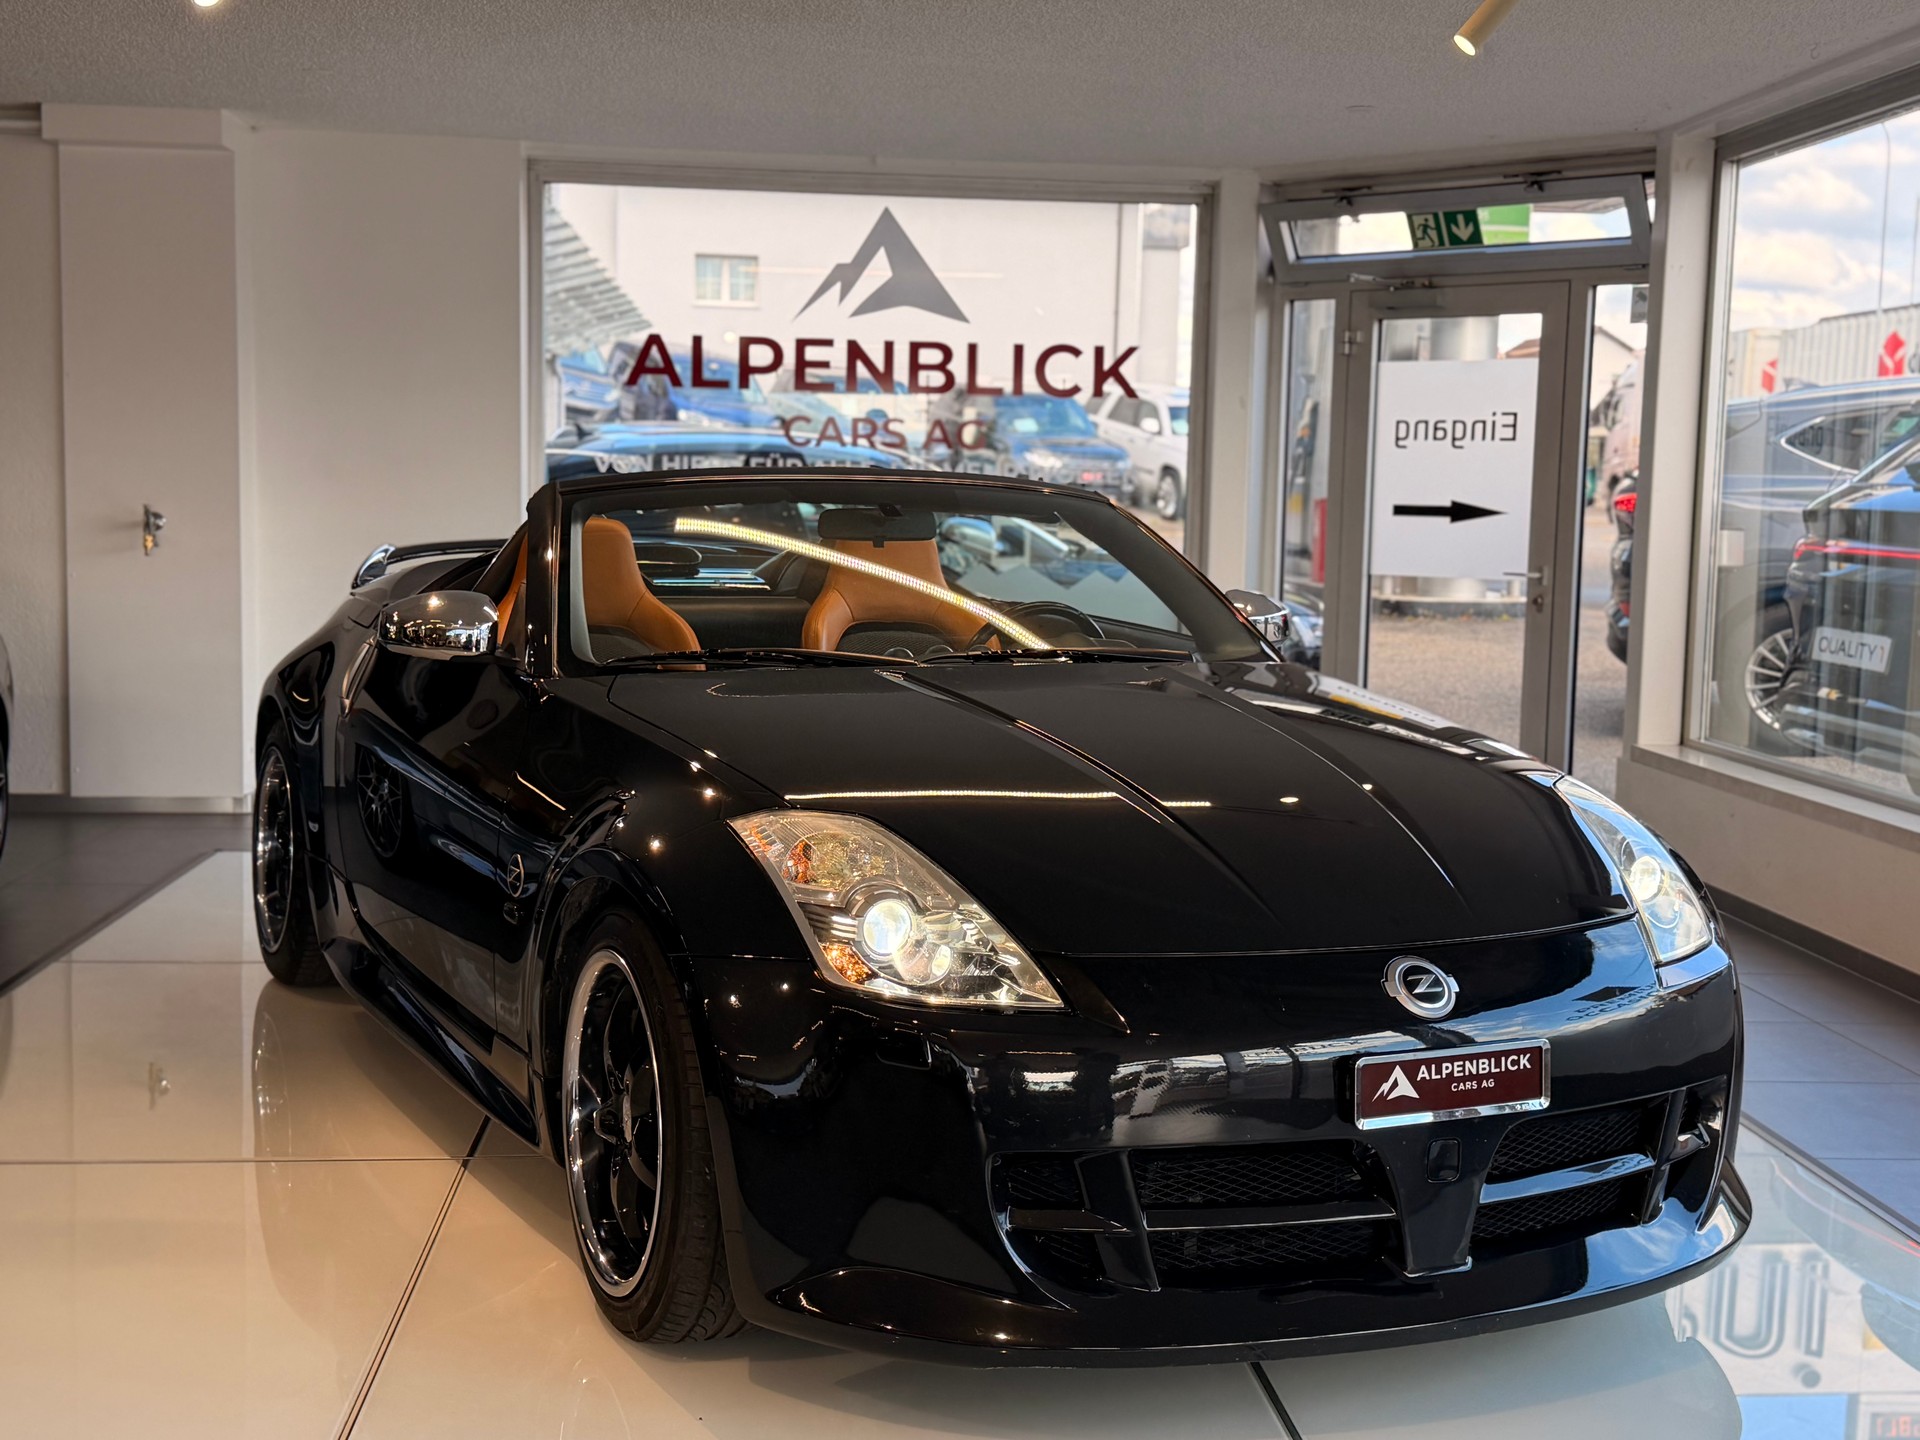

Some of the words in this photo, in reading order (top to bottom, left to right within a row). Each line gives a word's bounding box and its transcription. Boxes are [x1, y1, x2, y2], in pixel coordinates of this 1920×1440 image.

[624, 334, 1139, 398] ALPENBLICK
[784, 416, 907, 449] CARS
[923, 419, 987, 450] AG
[1407, 974, 1443, 994] Z
[1416, 1053, 1532, 1081] ALPENBLICK
[1451, 1080, 1478, 1092] CARS
[1481, 1078, 1495, 1089] AG
